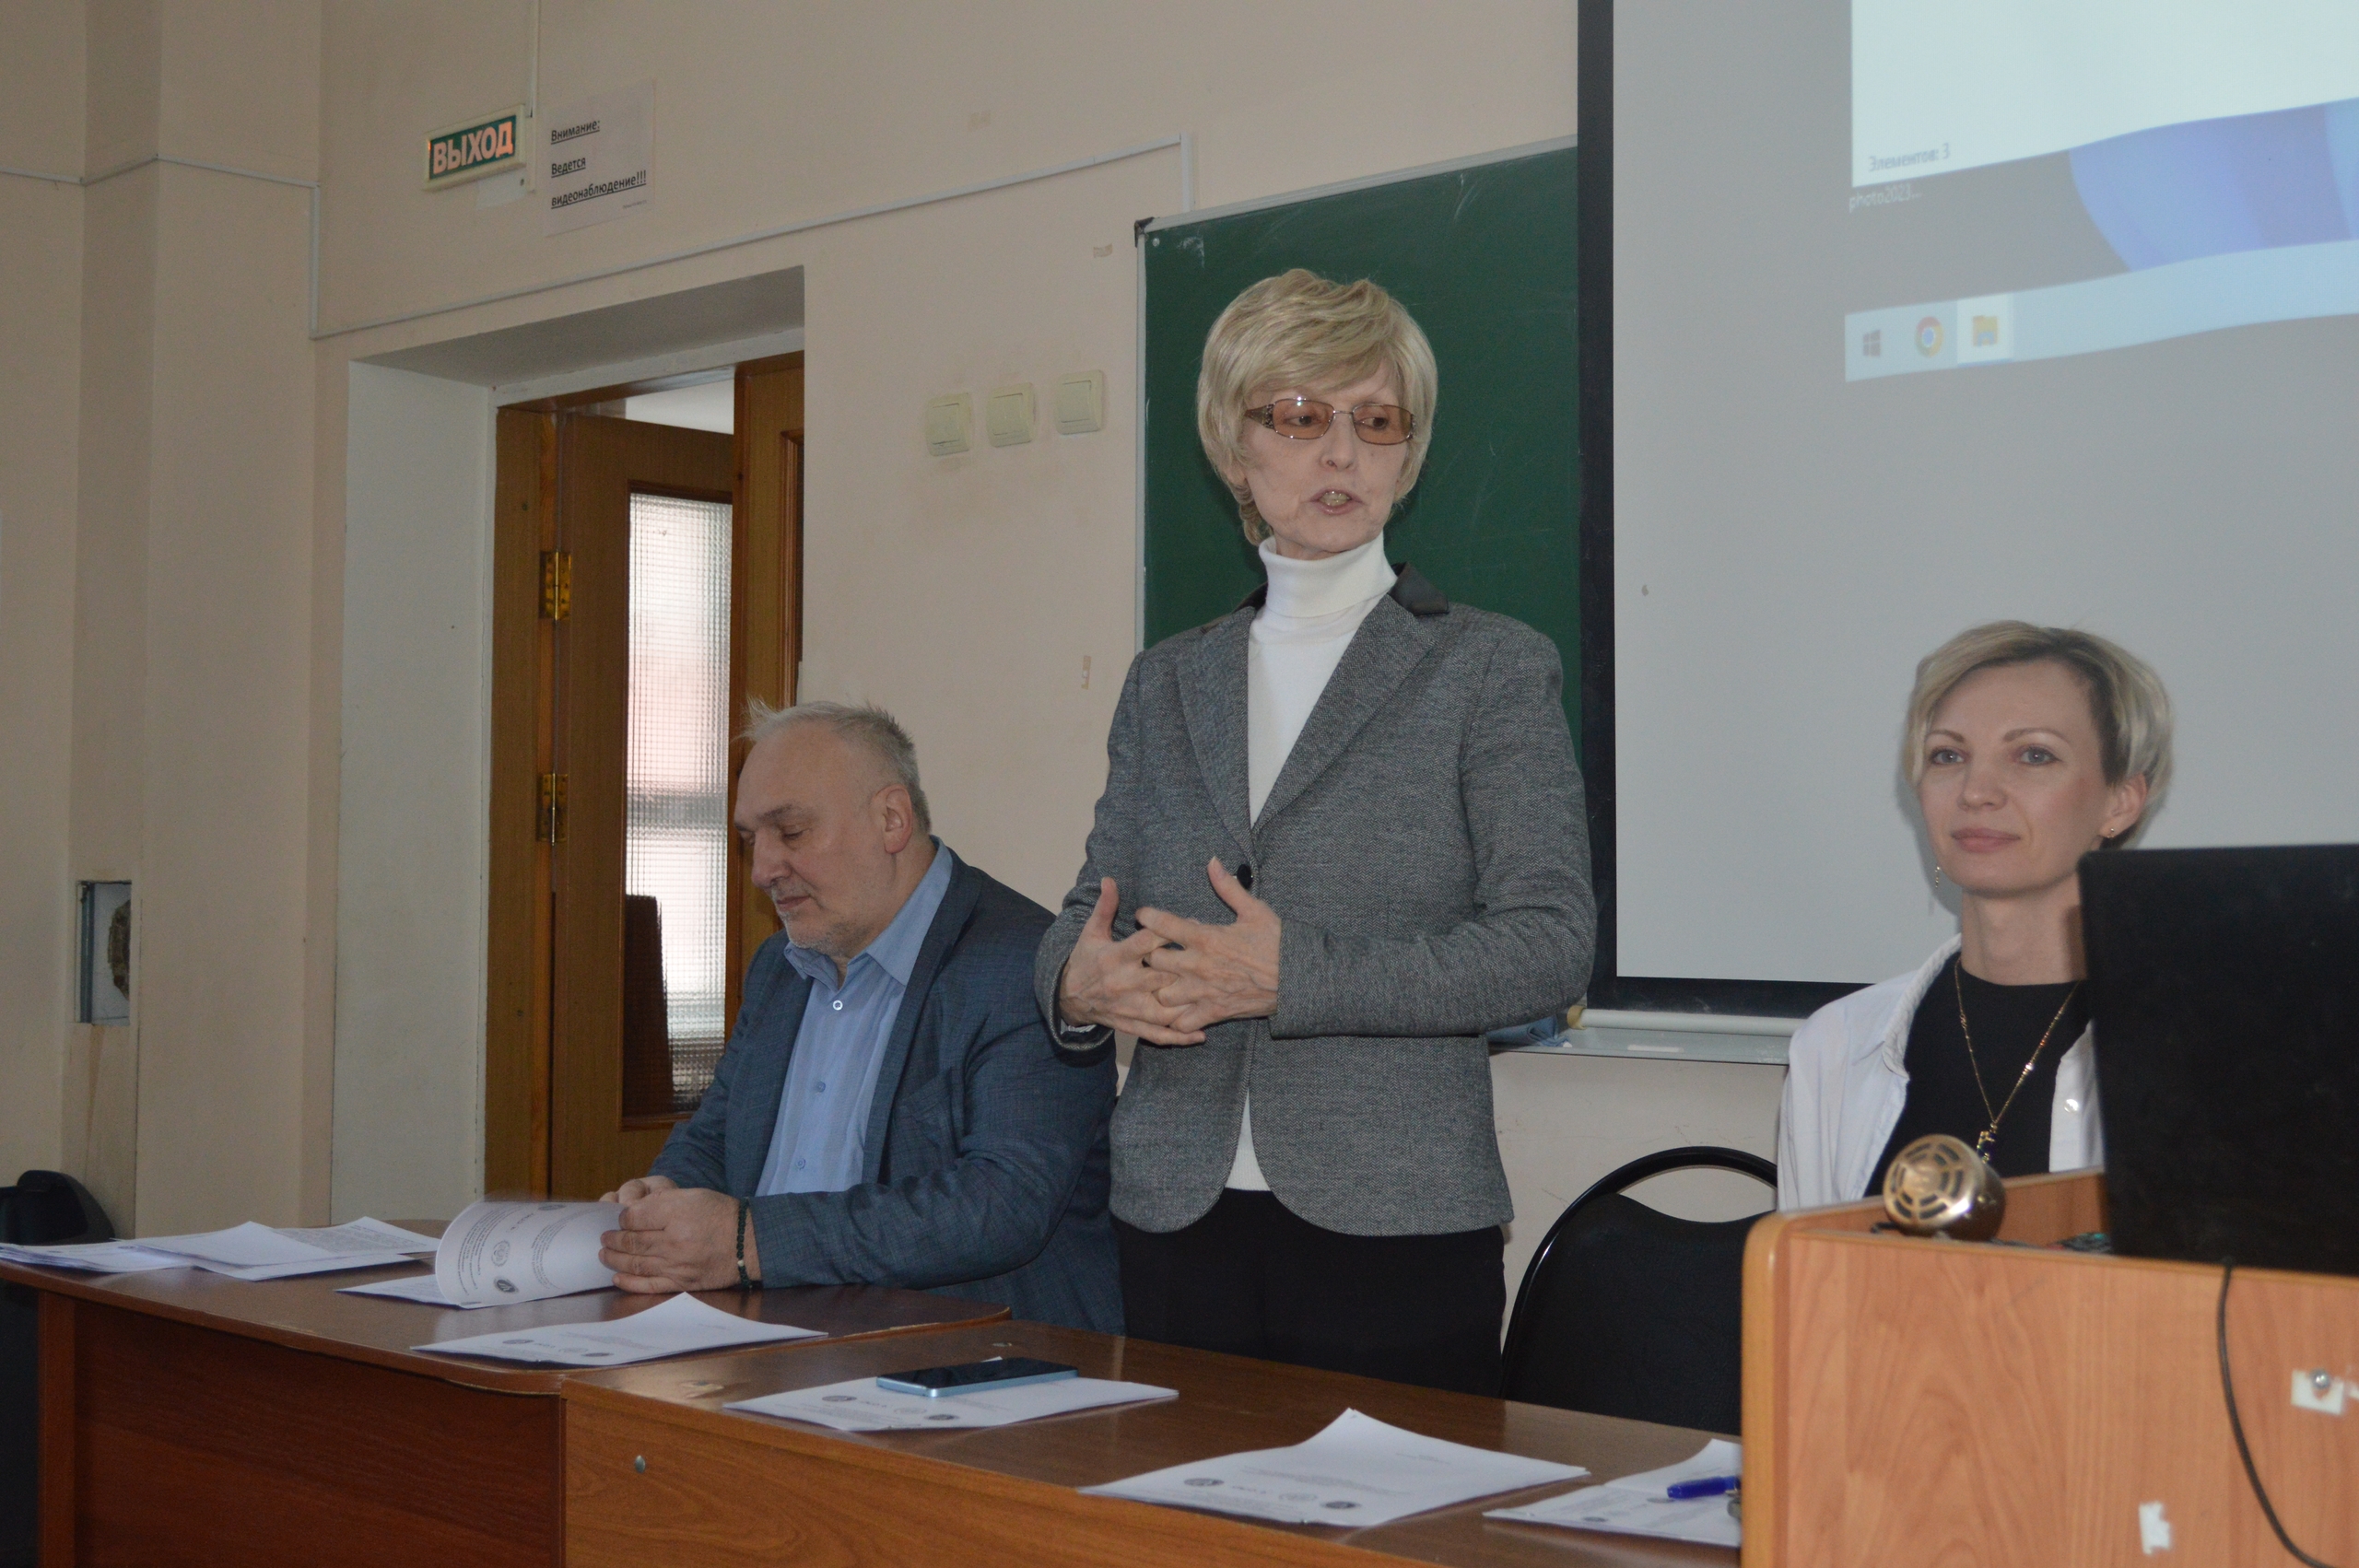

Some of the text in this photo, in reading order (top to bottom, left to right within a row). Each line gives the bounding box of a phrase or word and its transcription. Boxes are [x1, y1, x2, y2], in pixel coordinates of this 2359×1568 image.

[551, 120, 600, 144] Внимание:
[433, 122, 513, 174] ВЫХОД
[1942, 142, 1951, 160] 3
[551, 158, 587, 177] Ведется
[551, 170, 647, 208] видеонаблюдение!!!
